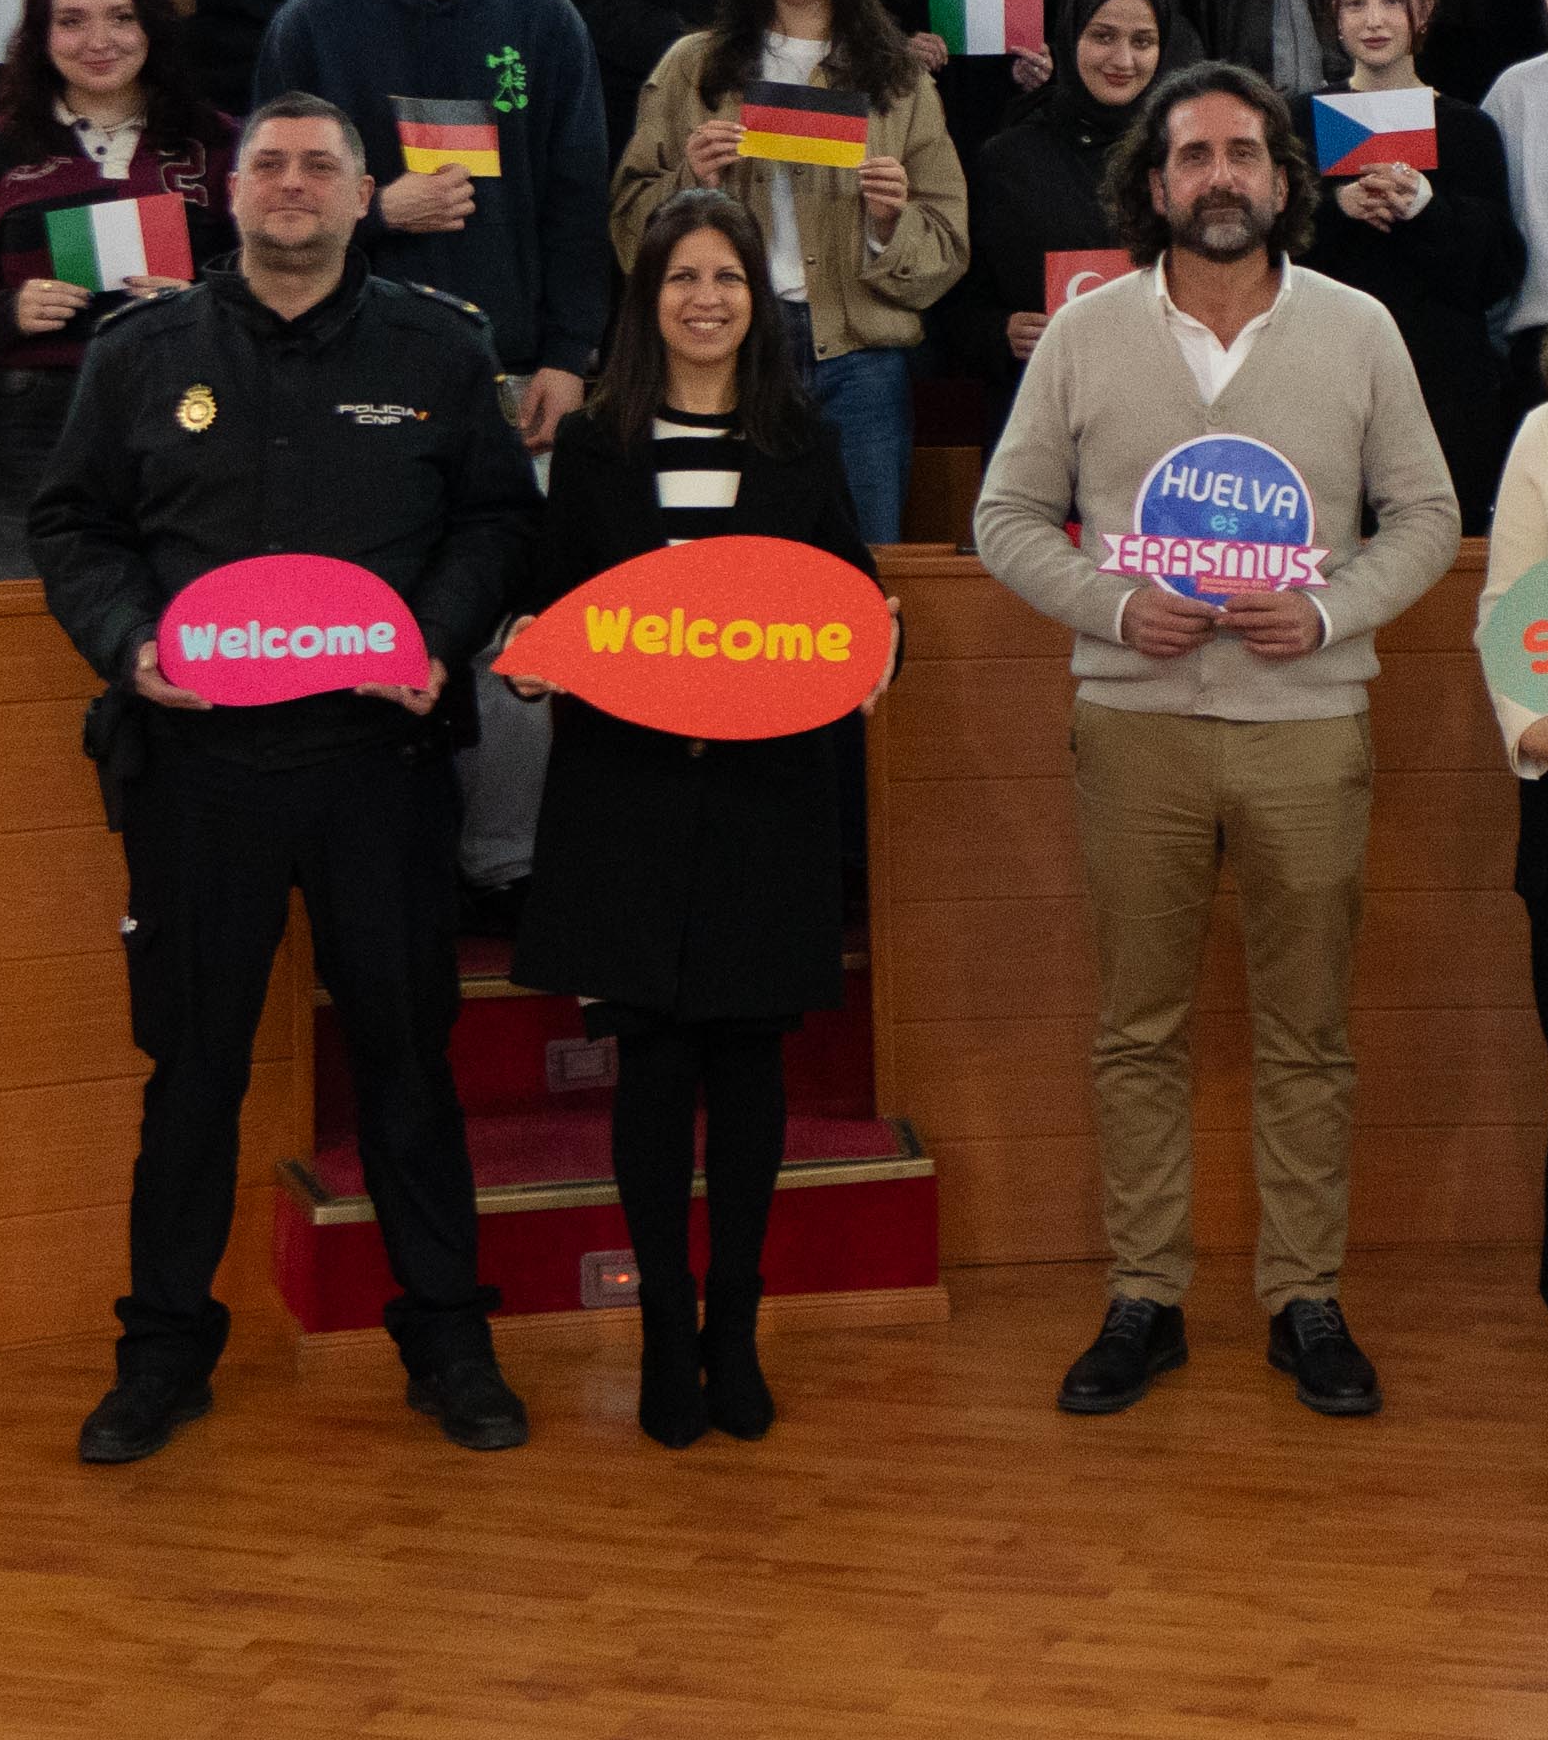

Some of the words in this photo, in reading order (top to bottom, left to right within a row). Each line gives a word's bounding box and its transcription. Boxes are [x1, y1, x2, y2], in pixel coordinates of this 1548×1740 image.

[336, 404, 416, 417] POLICIA
[356, 414, 403, 425] CNP
[1161, 463, 1300, 520] HUELVA
[1210, 513, 1239, 534] es
[1118, 535, 1312, 586] ERASMUS
[179, 620, 397, 662] Welcome
[584, 605, 853, 662] Welcome
